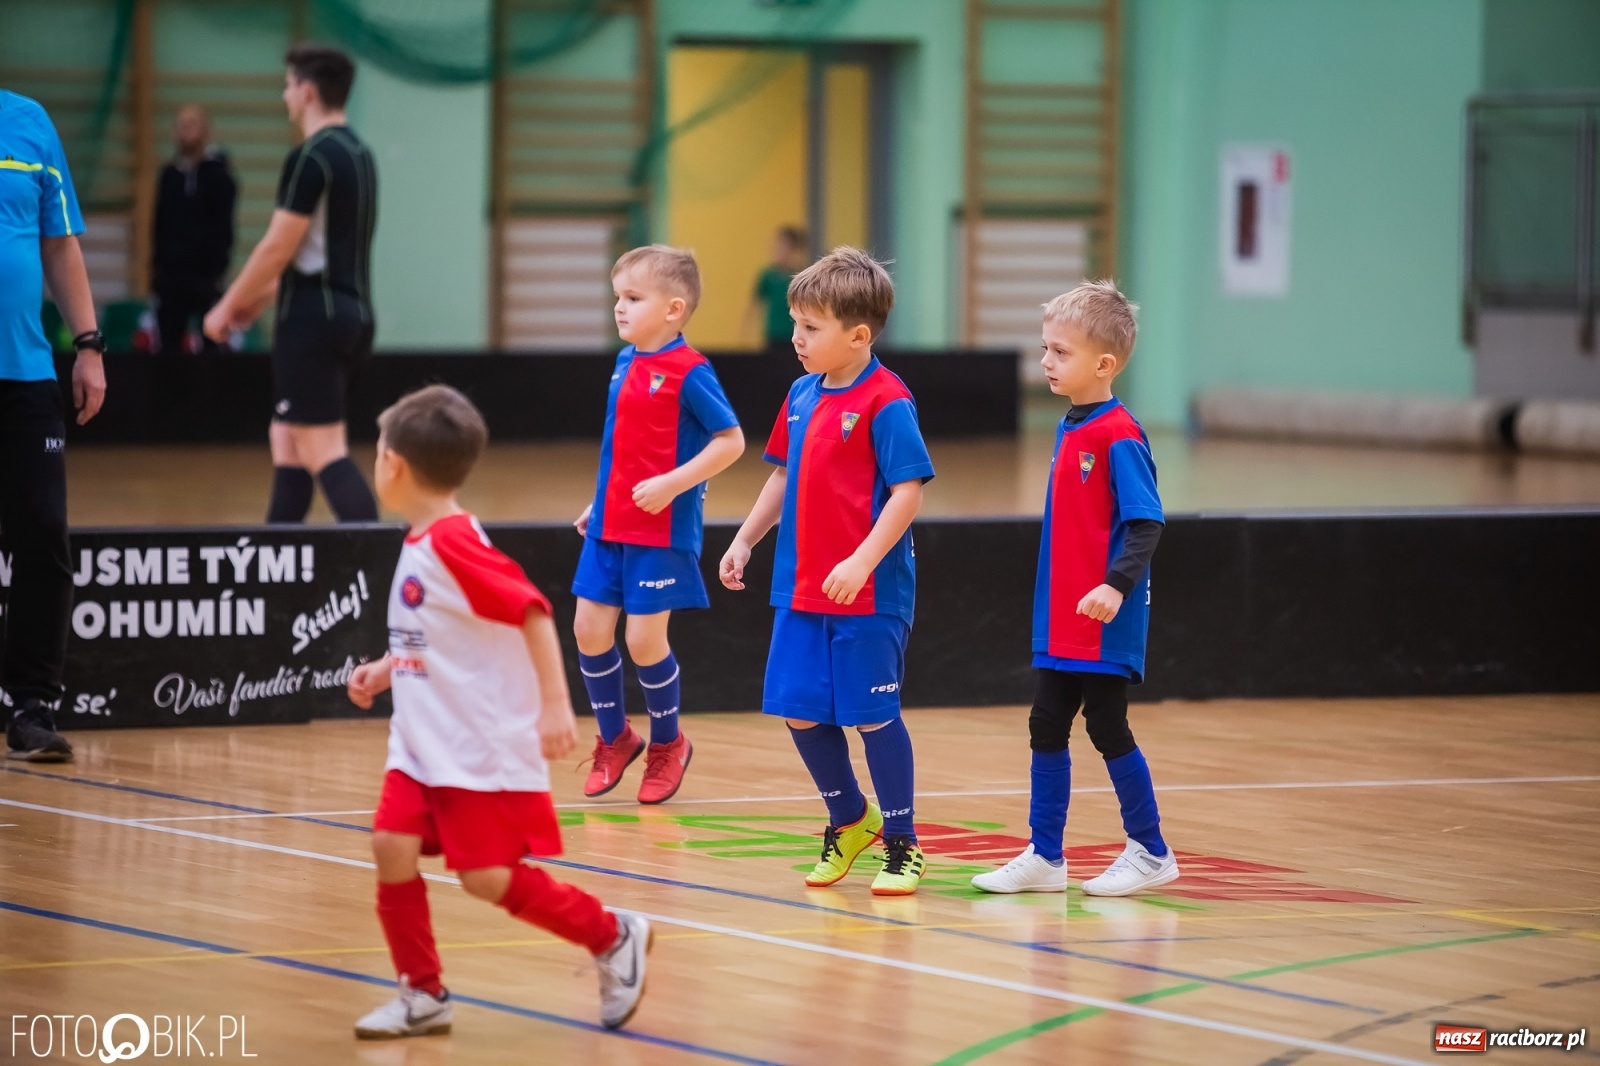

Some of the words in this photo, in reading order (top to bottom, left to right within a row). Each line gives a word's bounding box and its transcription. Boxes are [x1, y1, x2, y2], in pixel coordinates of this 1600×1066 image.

[72, 548, 190, 587] JSME
[200, 537, 314, 584] TÝM!
[638, 577, 676, 590] regio
[71, 589, 265, 640] OHUMÍN
[73, 687, 118, 716] se!
[870, 681, 899, 694] regi
